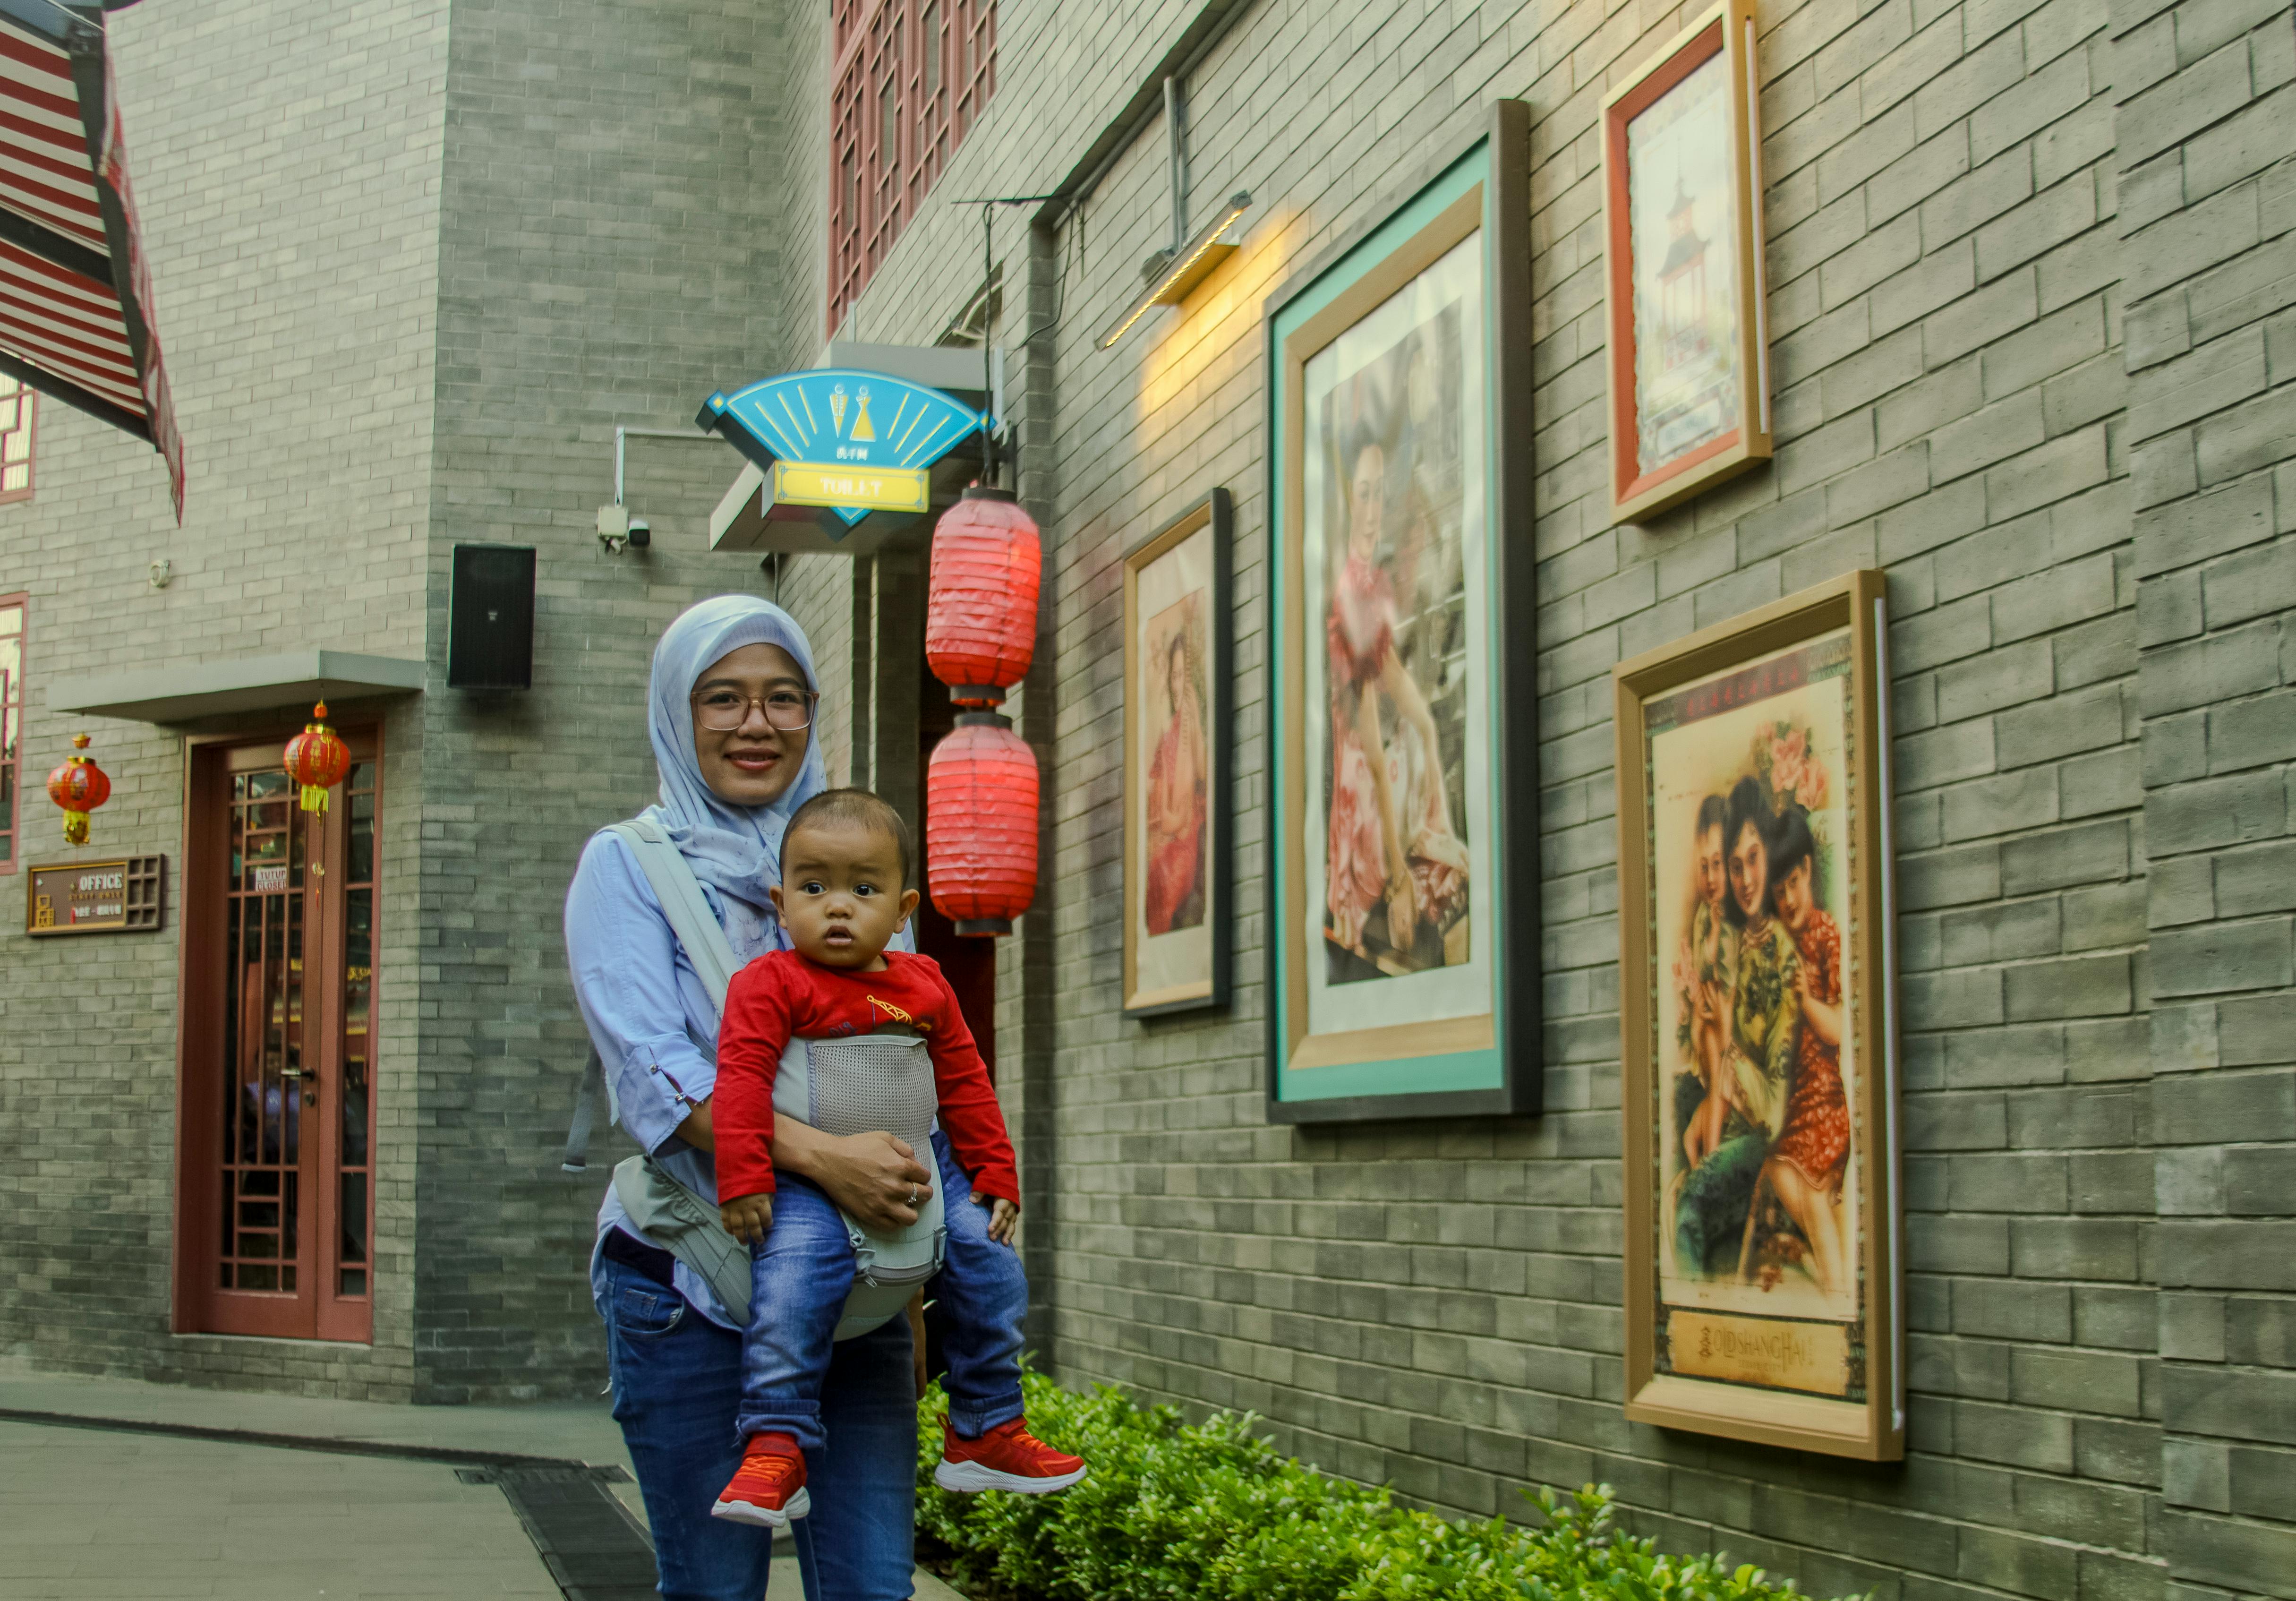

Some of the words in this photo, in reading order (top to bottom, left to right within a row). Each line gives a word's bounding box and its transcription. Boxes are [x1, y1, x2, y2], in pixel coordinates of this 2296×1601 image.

[820, 477, 882, 497] TOILET
[80, 873, 122, 891] OFFICE
[261, 870, 286, 879] TUTUP
